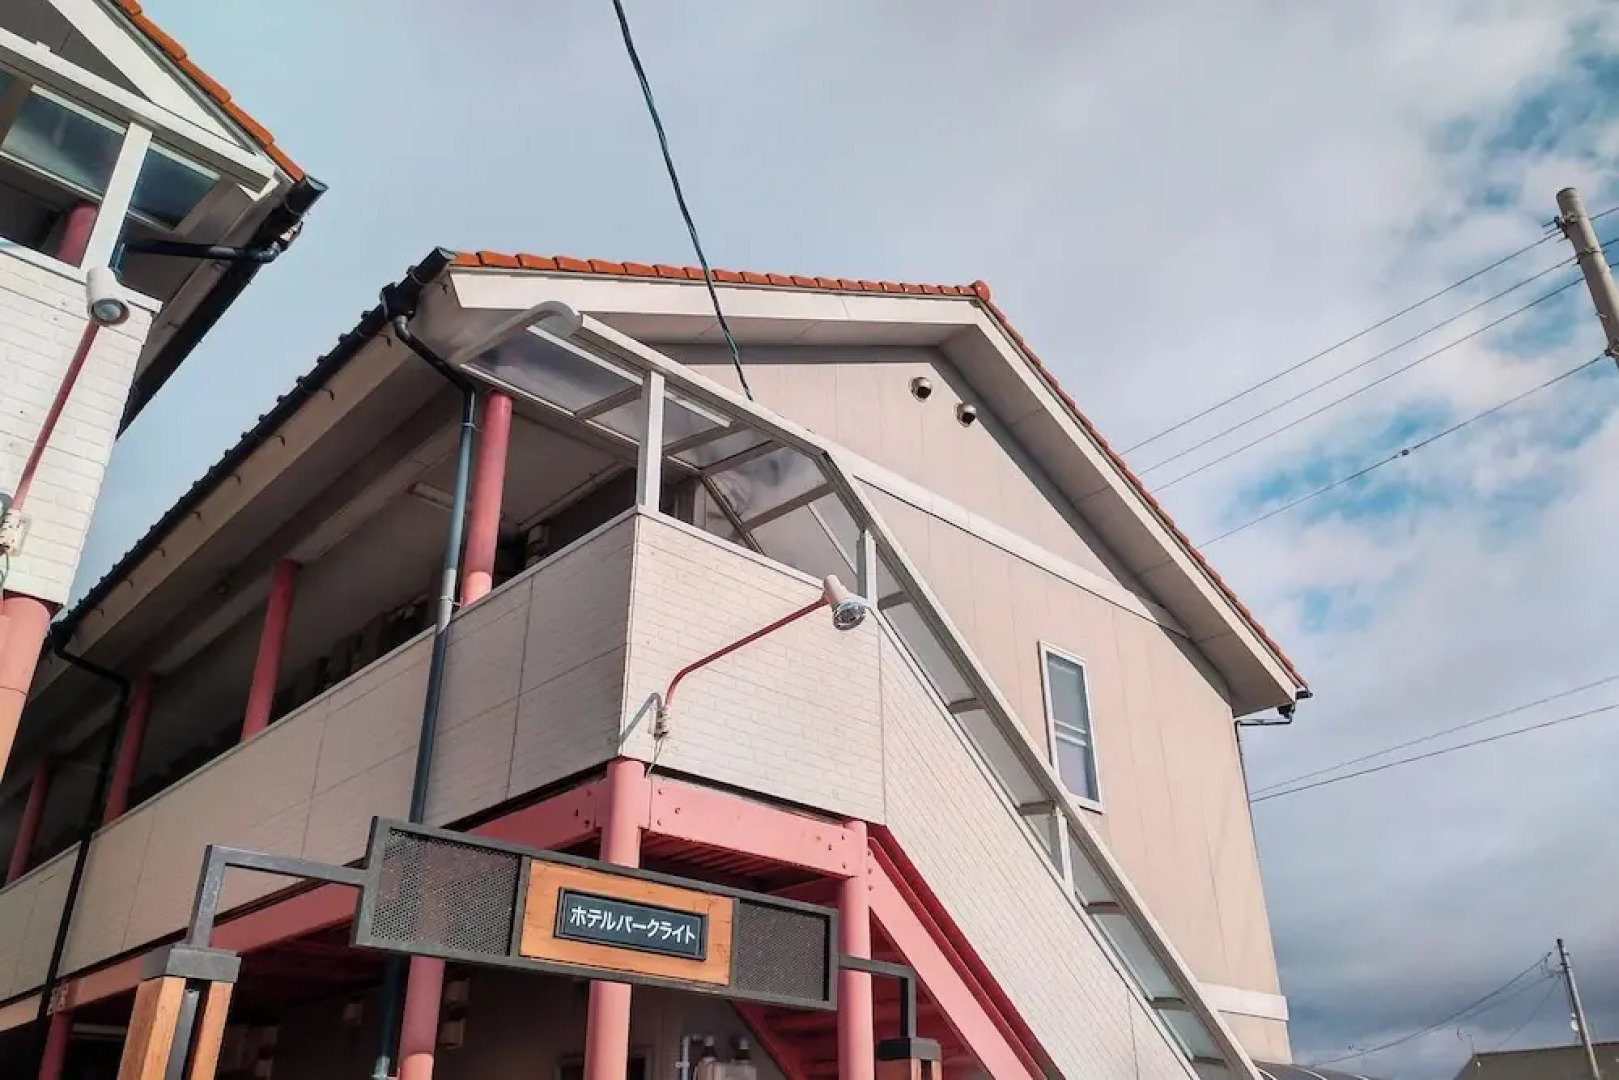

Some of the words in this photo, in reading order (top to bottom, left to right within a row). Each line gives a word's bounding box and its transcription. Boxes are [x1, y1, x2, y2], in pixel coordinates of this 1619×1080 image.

[569, 906, 696, 945] ホテルパークライト
